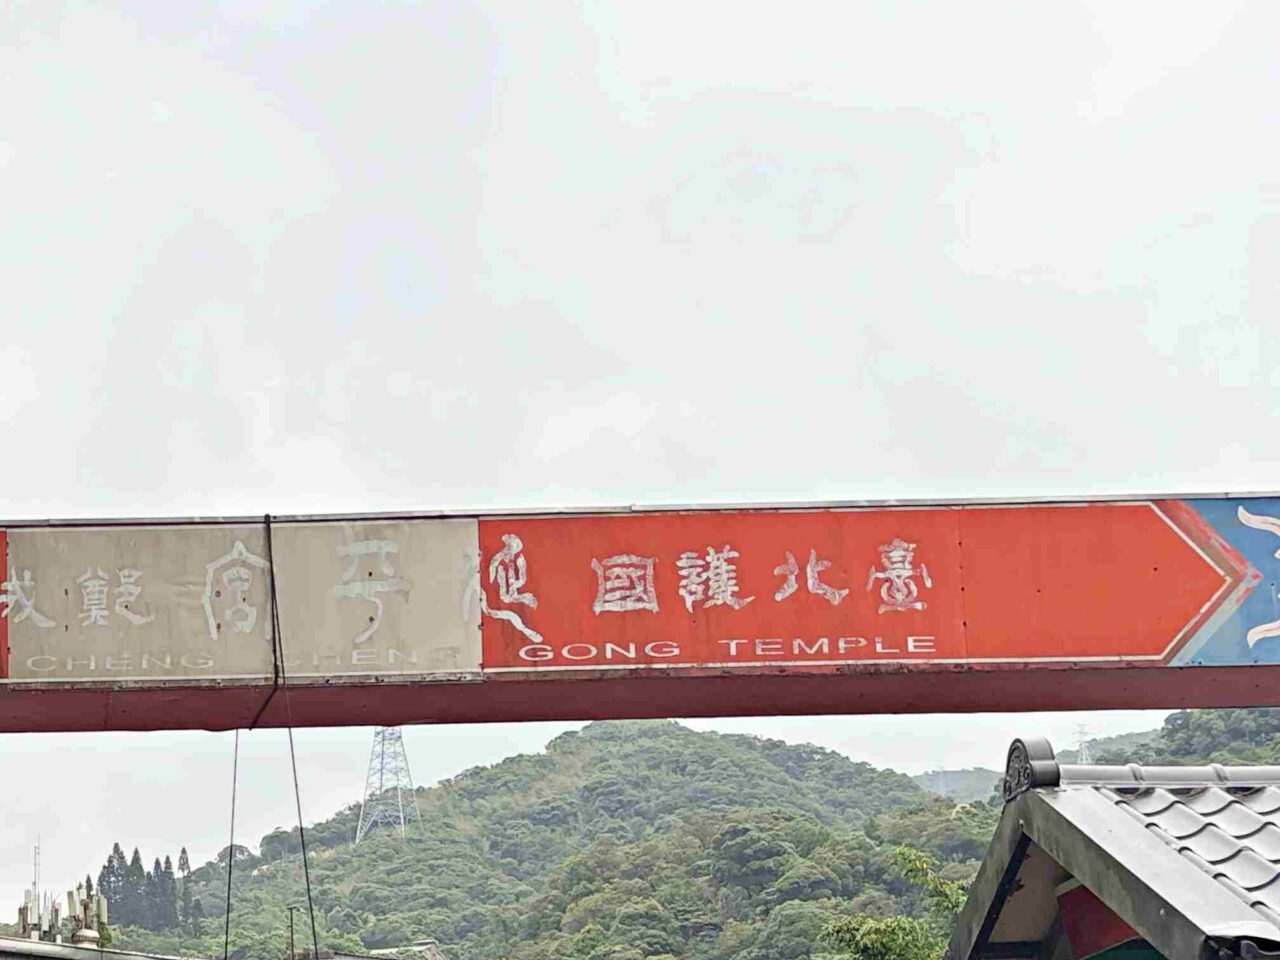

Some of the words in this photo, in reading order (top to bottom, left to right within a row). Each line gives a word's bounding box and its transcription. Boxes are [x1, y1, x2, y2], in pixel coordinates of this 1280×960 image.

[25, 653, 215, 671] CHENG
[274, 646, 463, 667] CHEN
[518, 641, 681, 661] GONG
[717, 635, 937, 656] TEMPLE
